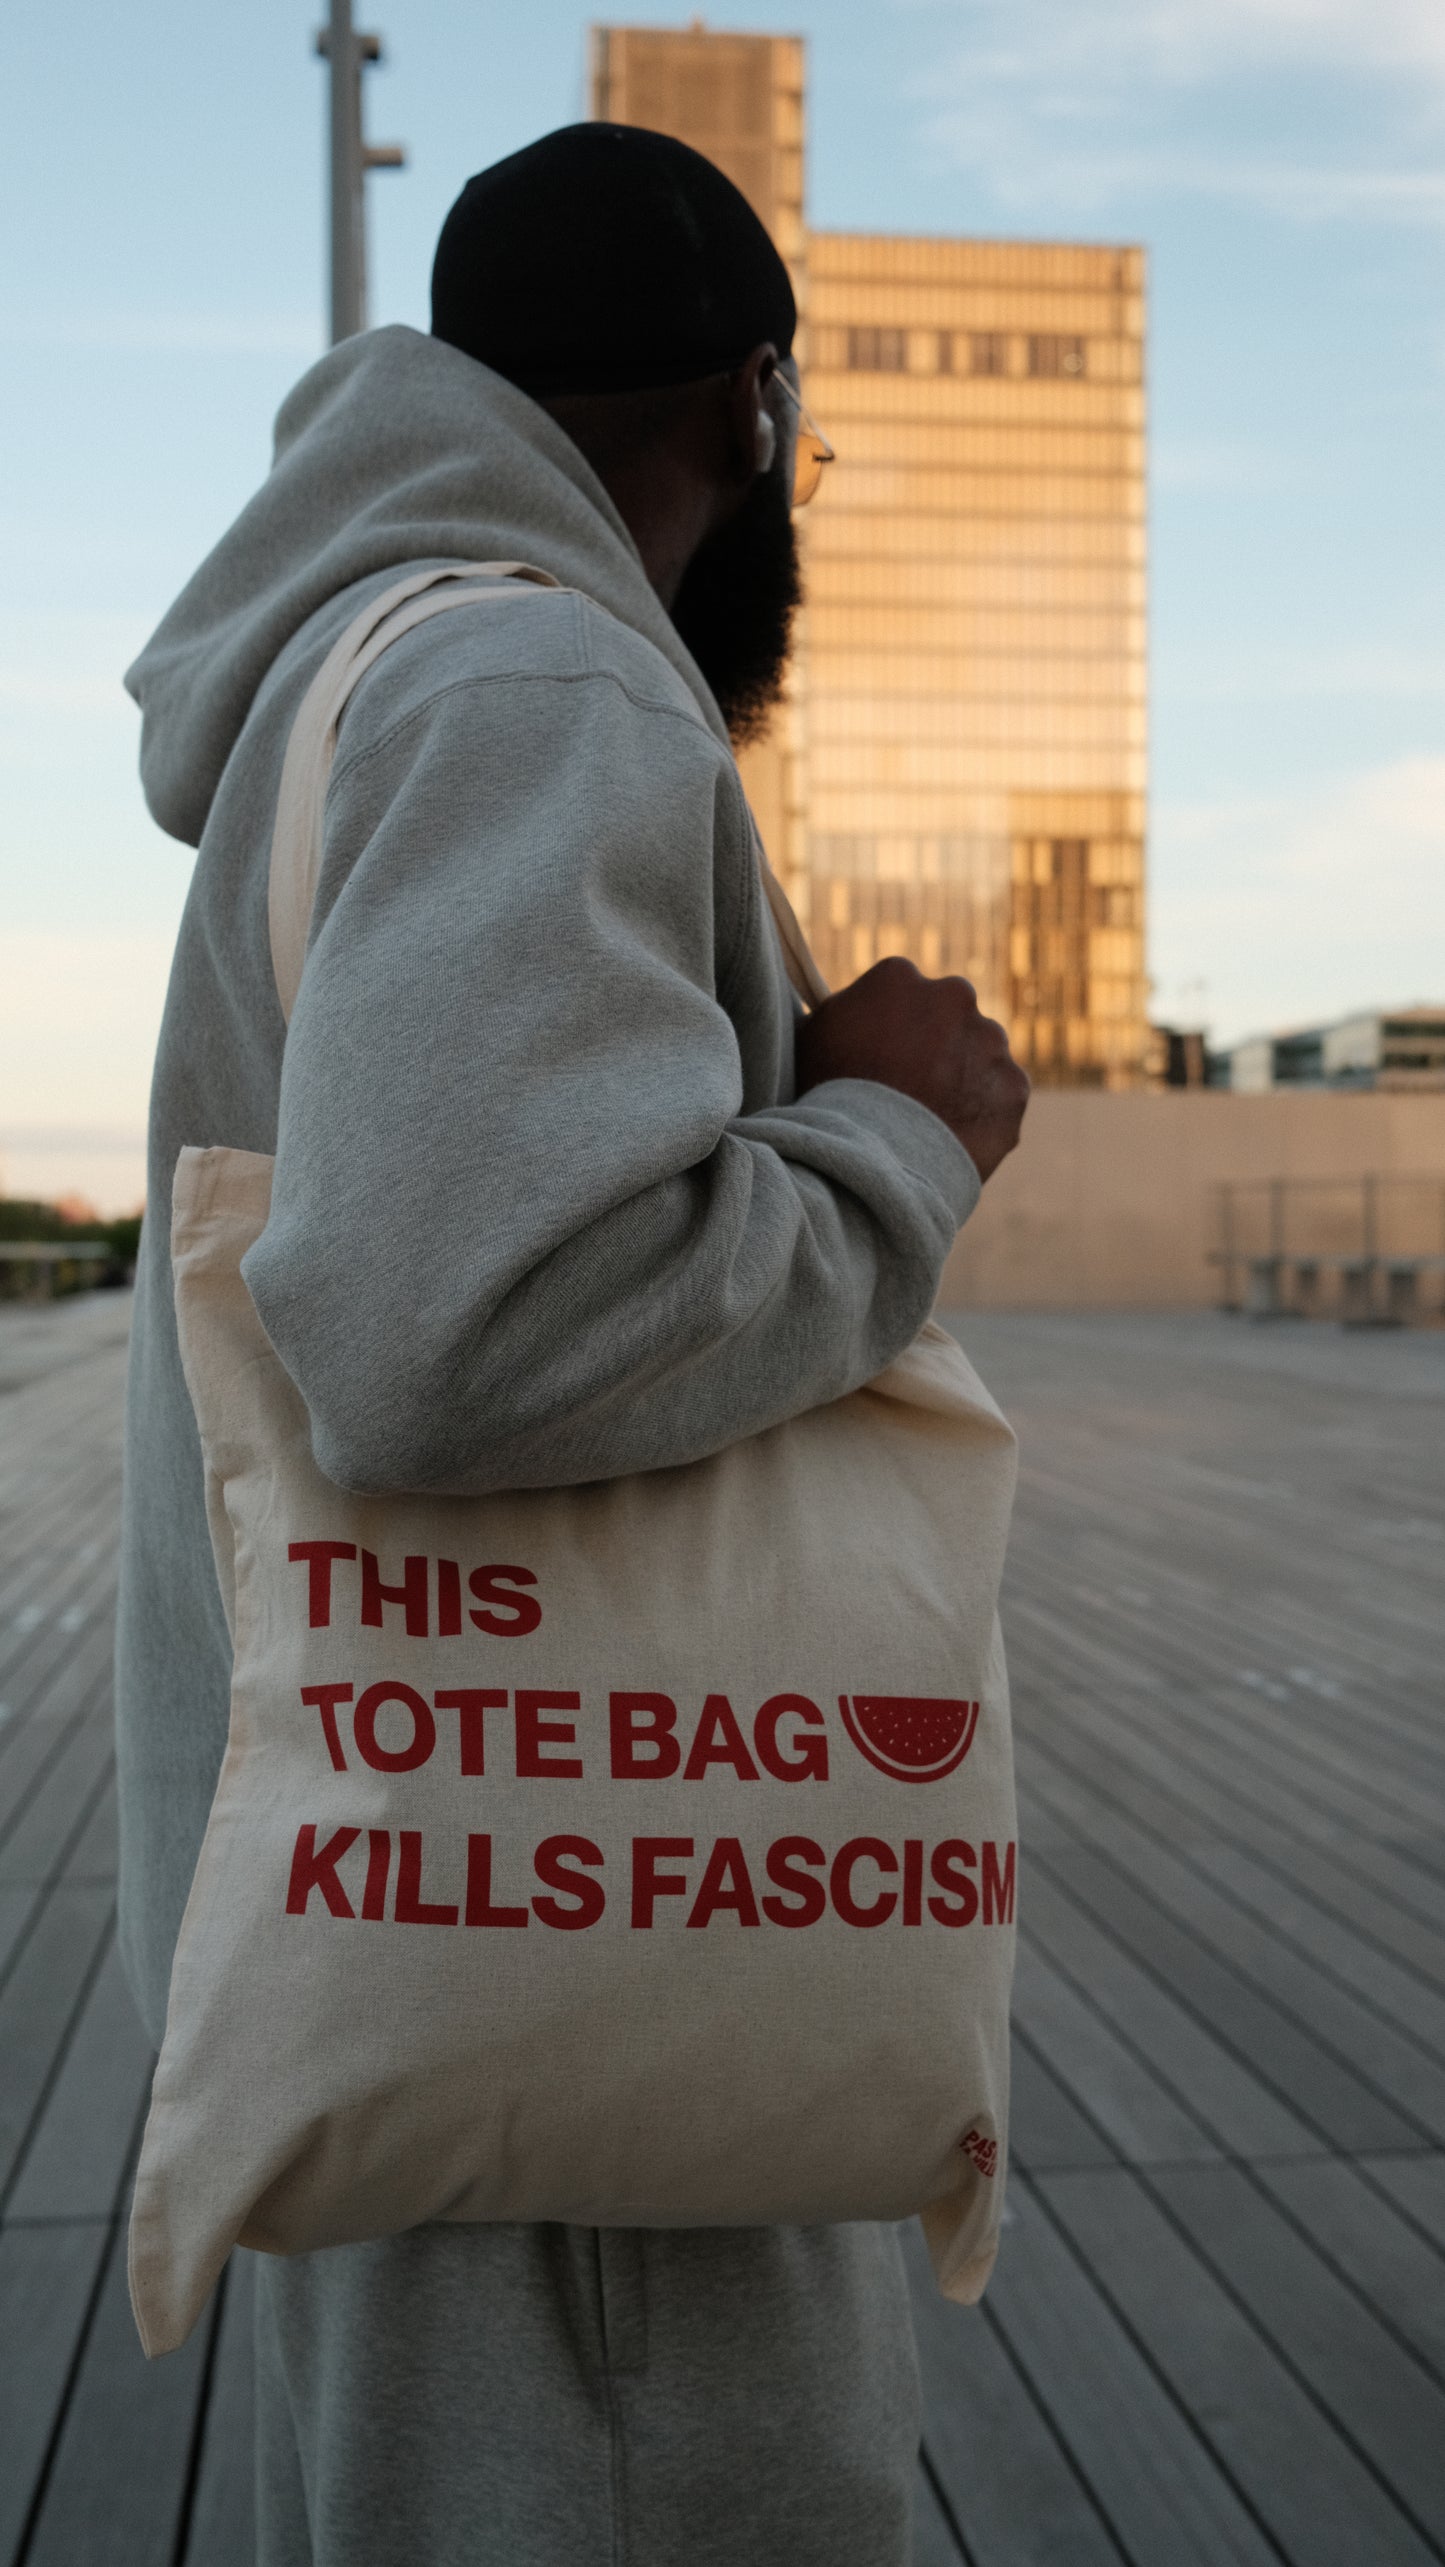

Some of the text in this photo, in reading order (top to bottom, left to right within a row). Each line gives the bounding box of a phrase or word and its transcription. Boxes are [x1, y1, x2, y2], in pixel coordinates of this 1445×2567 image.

[288, 1540, 542, 1638] THIS
[300, 1681, 829, 1783] TOTE BAG
[285, 1823, 1016, 1930] KILLS FASCISM
